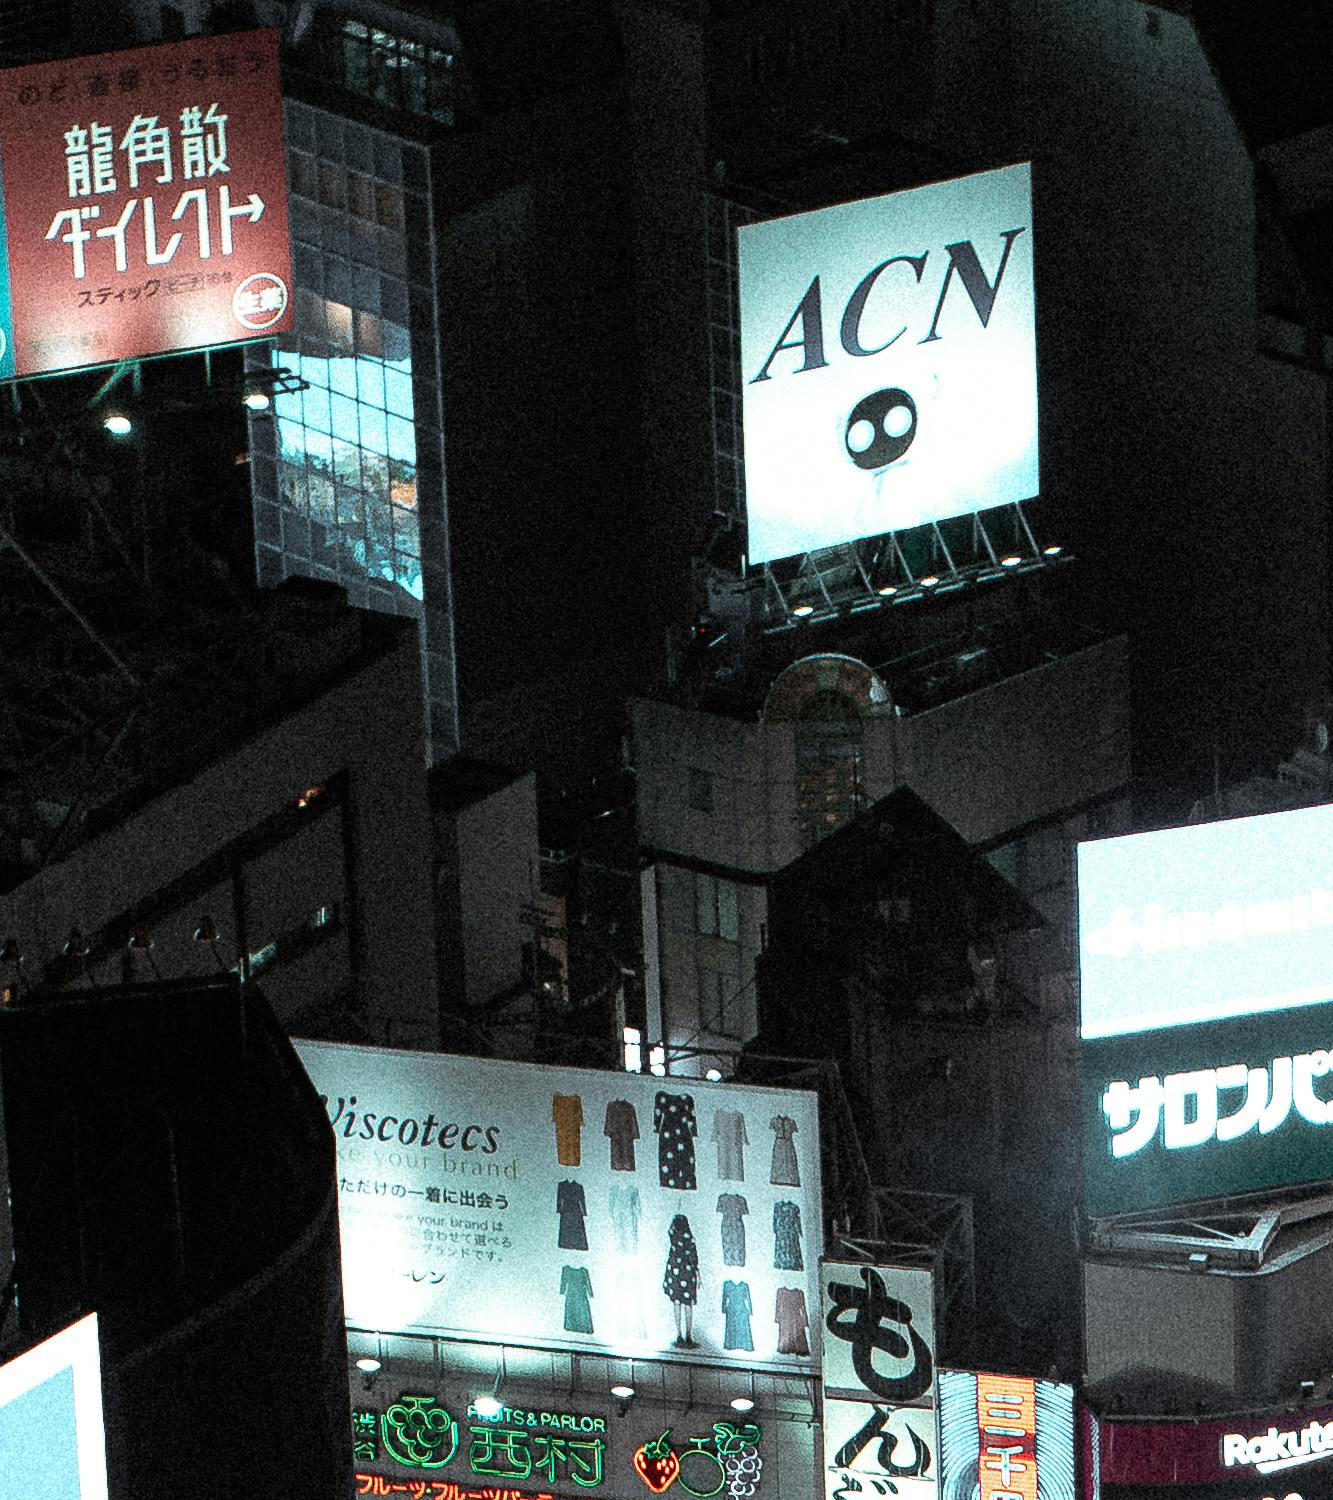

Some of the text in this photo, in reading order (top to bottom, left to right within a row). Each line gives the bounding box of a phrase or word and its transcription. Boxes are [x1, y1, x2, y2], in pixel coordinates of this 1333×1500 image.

[63, 102, 231, 198] 龍角散
[44, 184, 265, 279] ダイレクト
[77, 278, 161, 308] スティック
[748, 227, 1028, 384] ACN
[443, 1152, 520, 1180] brand
[352, 1412, 376, 1461] 渋谷
[541, 1413, 607, 1434] PARLOR
[469, 1426, 606, 1488] 西村
